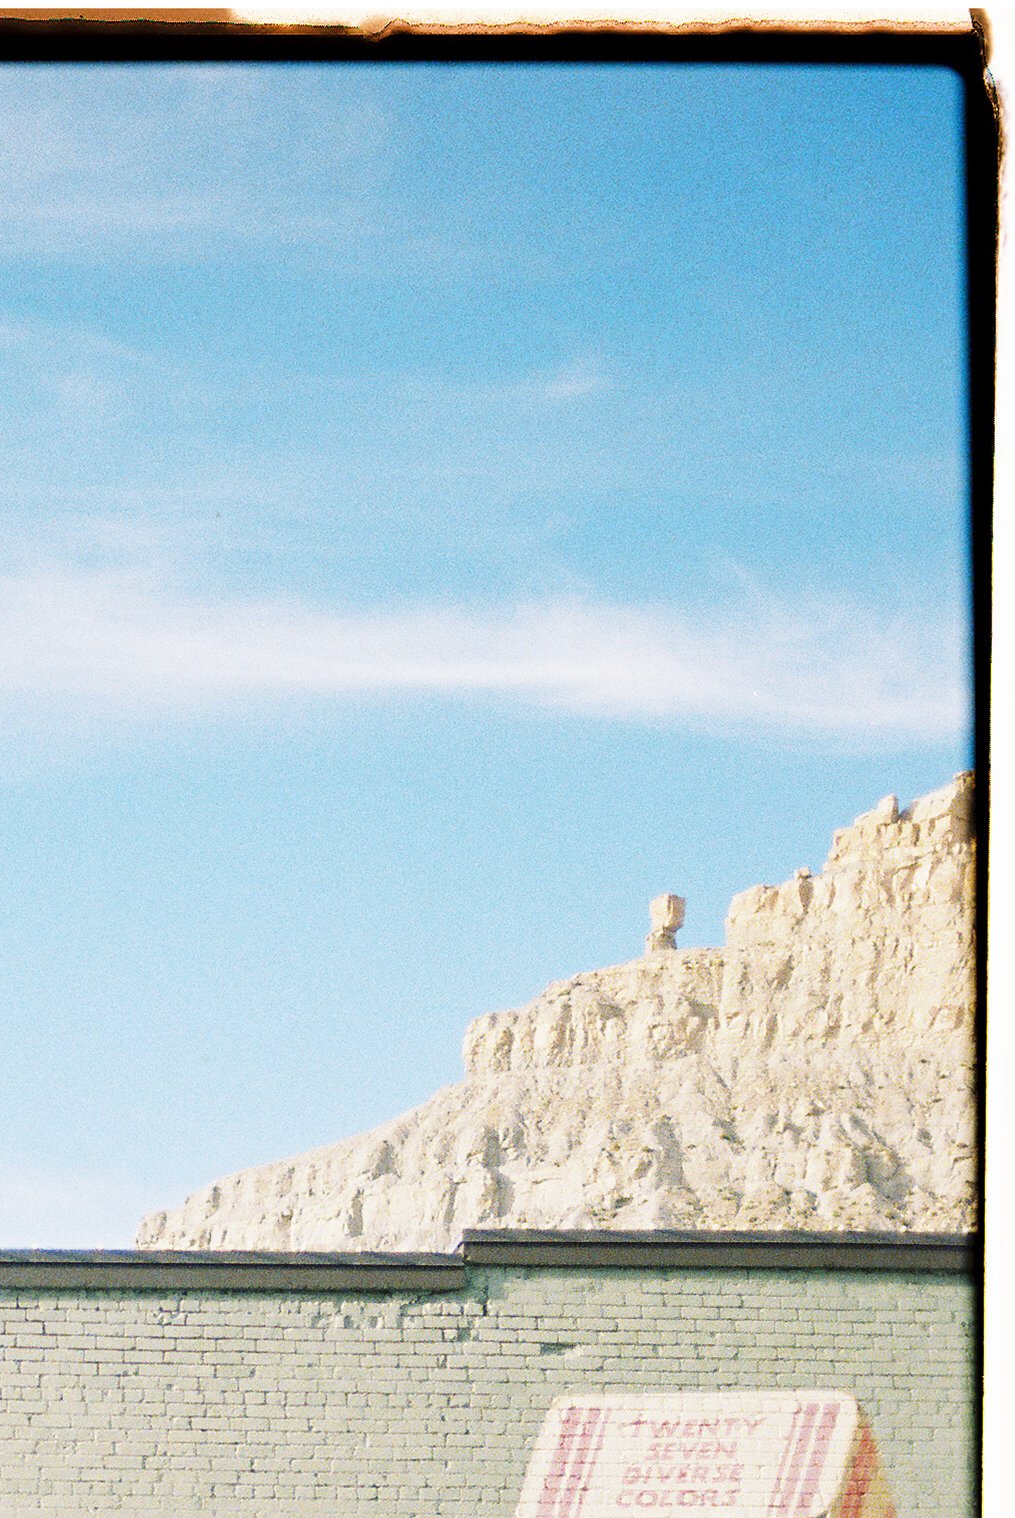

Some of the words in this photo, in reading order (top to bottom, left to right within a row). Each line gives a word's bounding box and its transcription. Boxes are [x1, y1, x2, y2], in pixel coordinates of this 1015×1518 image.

[626, 1417, 767, 1437] TWENTY
[645, 1441, 737, 1461] SEVEN
[622, 1464, 745, 1485] DIVERSE
[615, 1488, 741, 1508] COLORS
